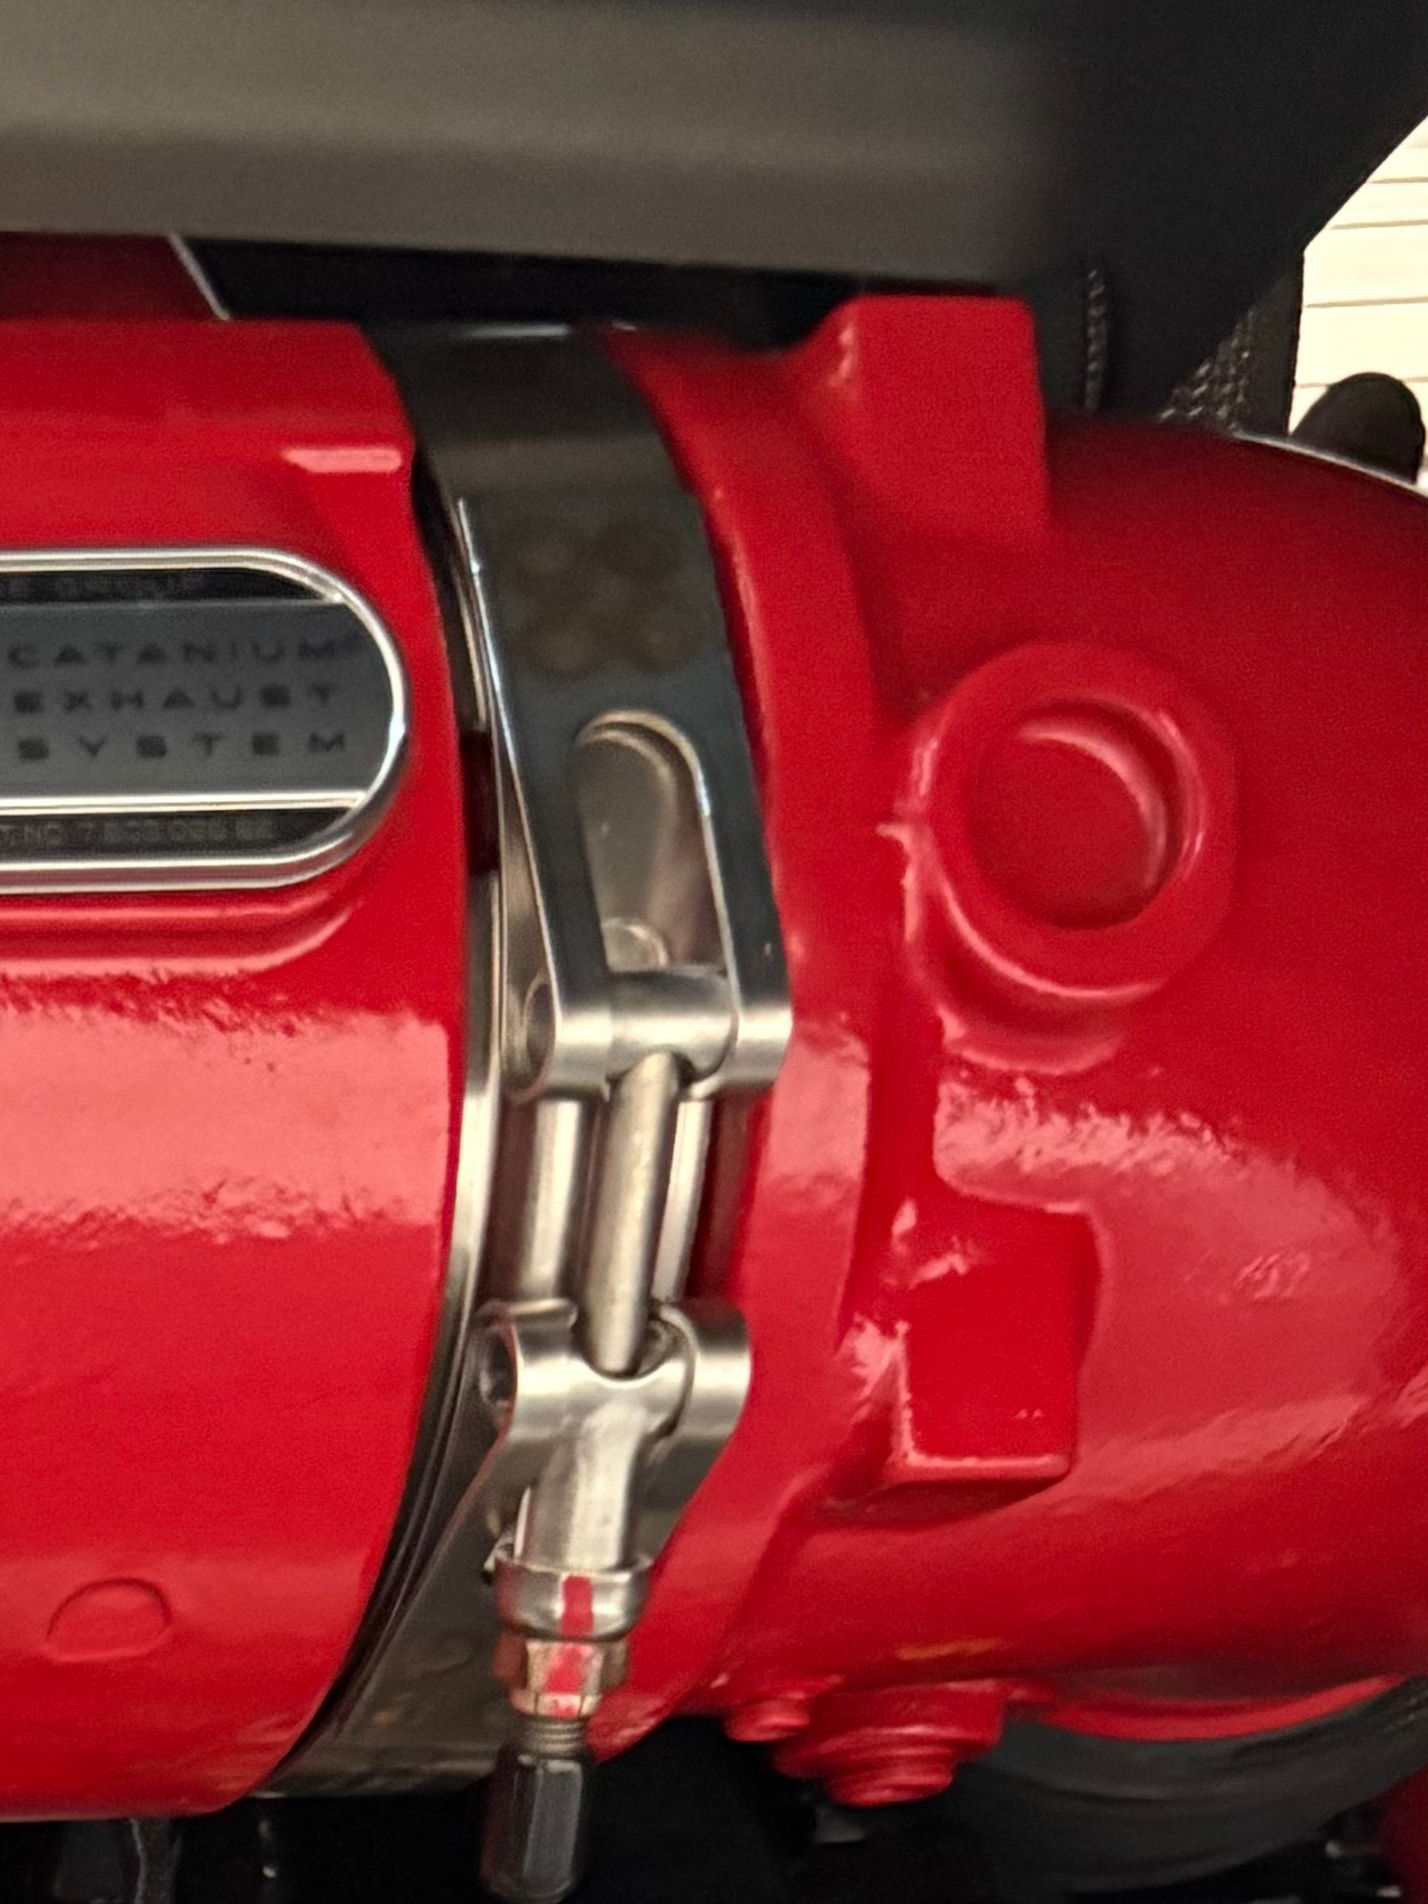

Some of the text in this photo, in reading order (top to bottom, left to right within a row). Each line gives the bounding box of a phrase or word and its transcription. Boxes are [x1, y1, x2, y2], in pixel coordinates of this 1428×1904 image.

[8, 638, 338, 668] CATANIUM
[14, 682, 333, 713] EXHAUST
[18, 732, 344, 760] SYSTEM
